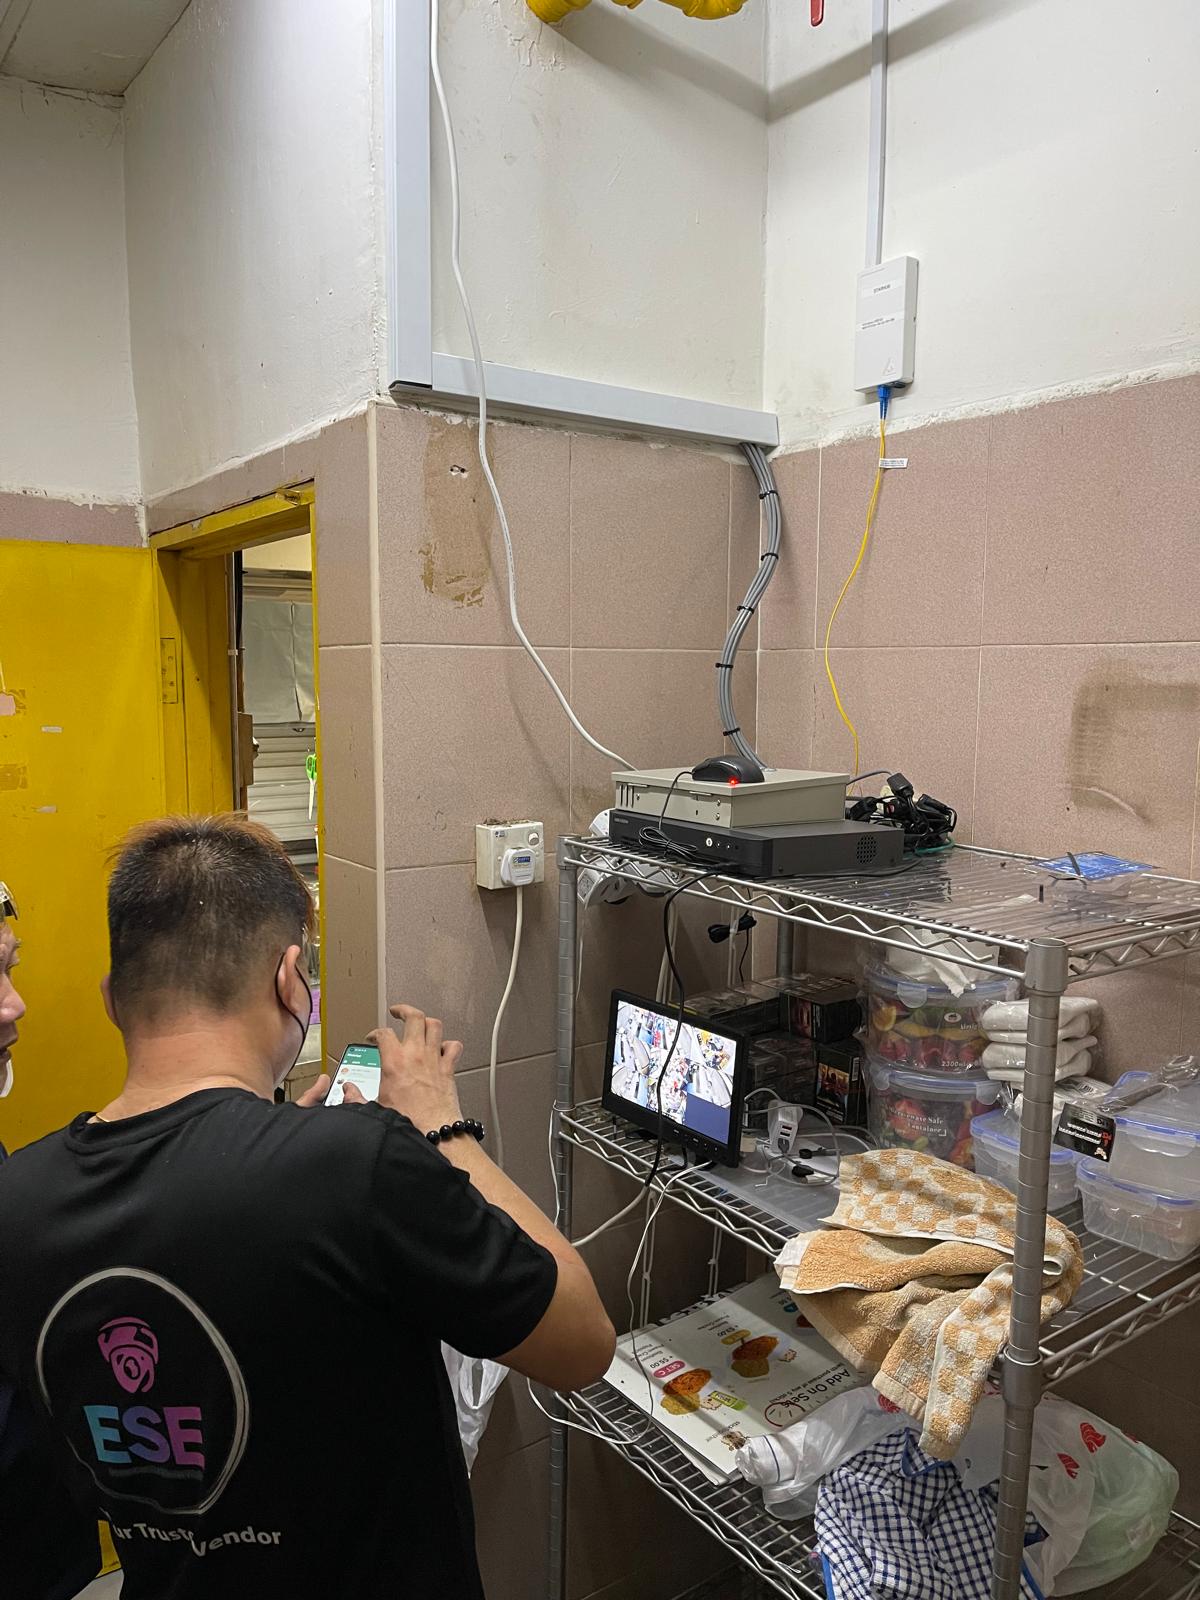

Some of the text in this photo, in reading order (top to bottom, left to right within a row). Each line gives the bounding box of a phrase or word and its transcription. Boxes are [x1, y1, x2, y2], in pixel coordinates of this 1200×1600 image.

[825, 1368, 851, 1388] Add
[807, 1381, 828, 1399] On
[83, 1405, 205, 1469] ESE
